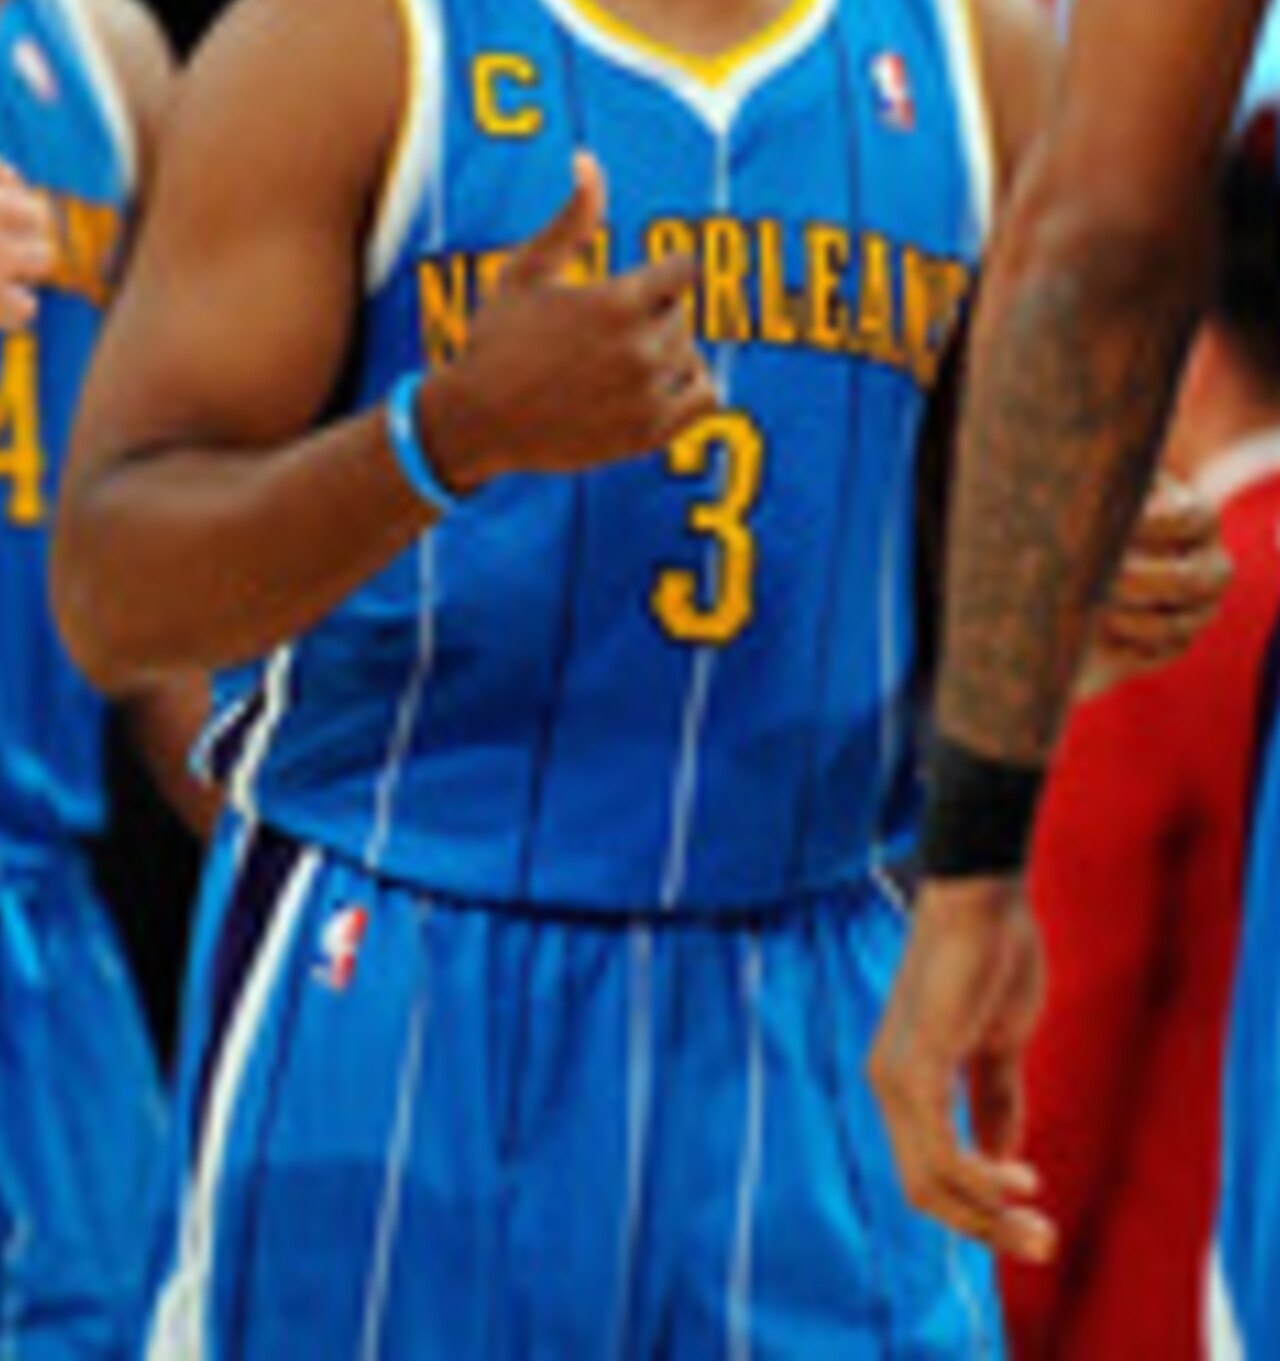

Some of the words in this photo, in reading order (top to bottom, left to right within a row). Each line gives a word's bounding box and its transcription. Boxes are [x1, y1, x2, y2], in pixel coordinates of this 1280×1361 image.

[471, 51, 543, 136] C
[646, 214, 966, 390] ORLEAN
[649, 408, 768, 646] 3
